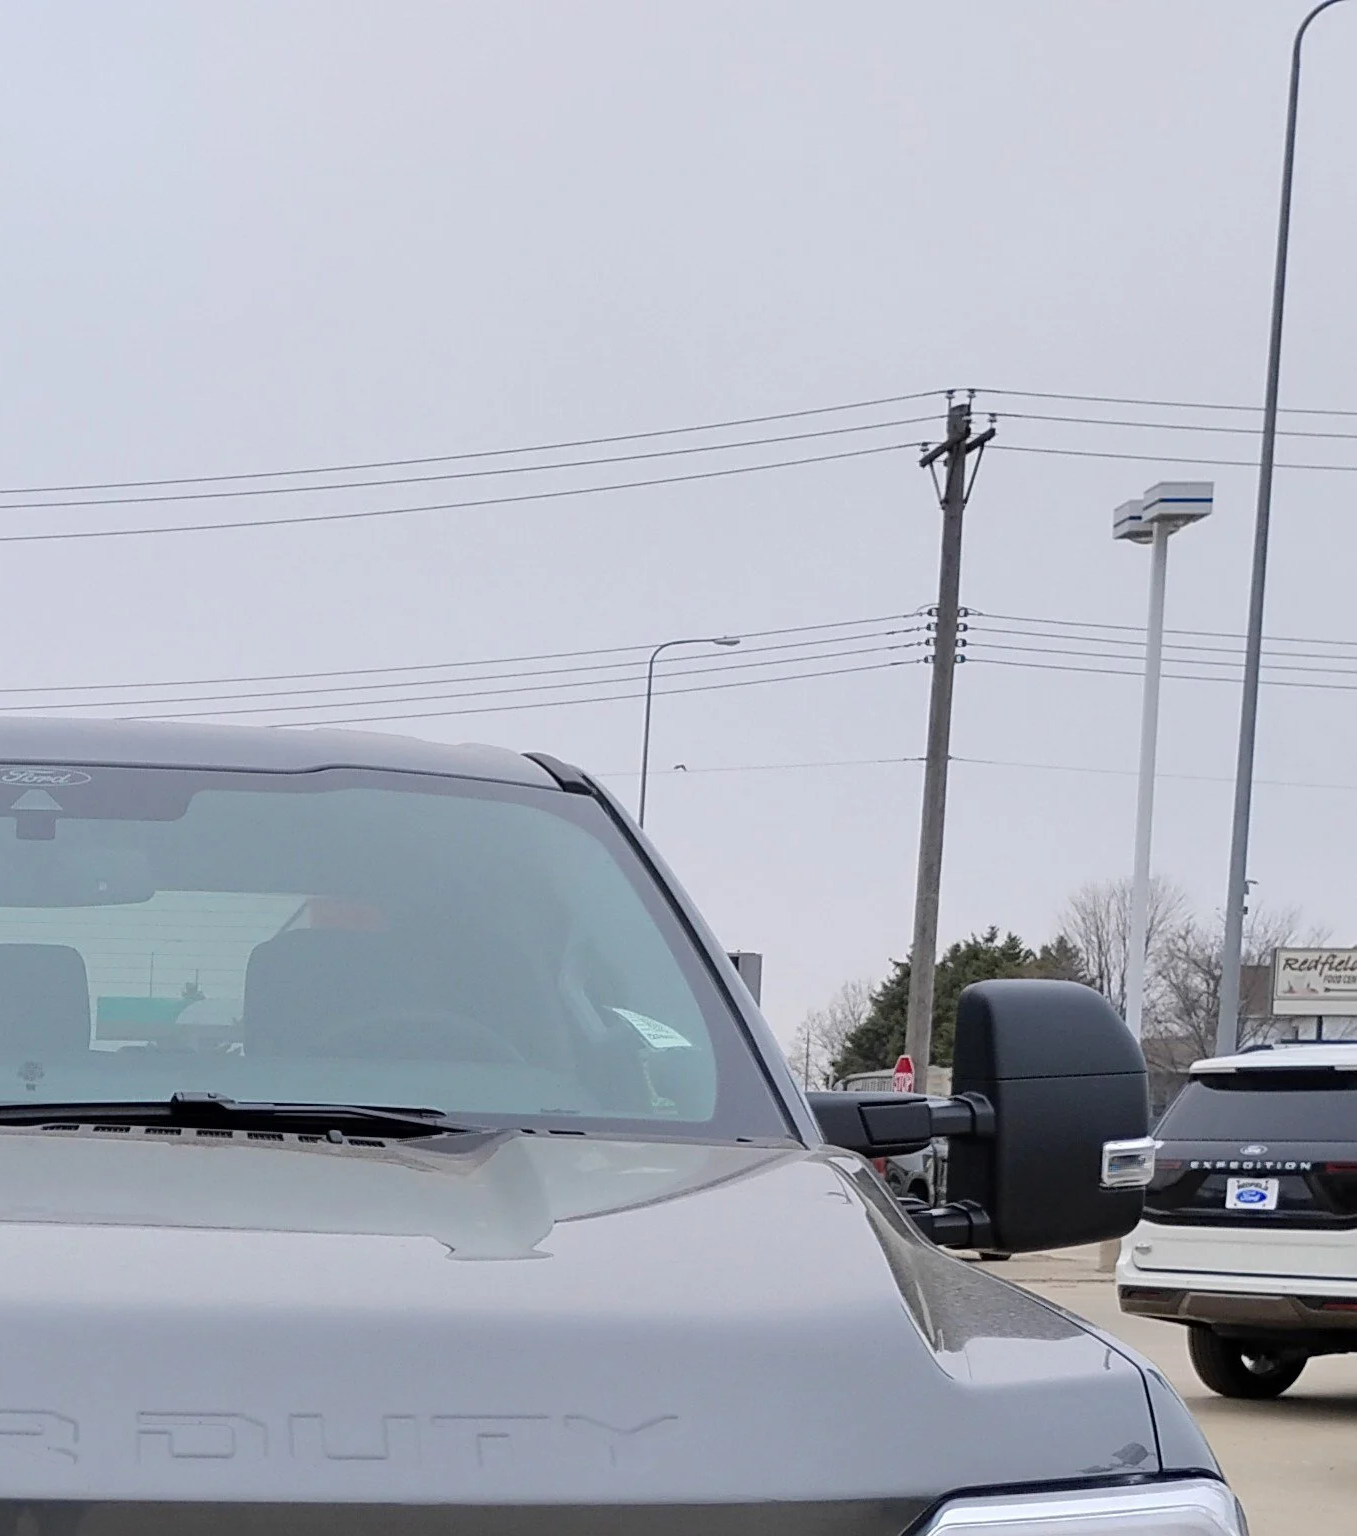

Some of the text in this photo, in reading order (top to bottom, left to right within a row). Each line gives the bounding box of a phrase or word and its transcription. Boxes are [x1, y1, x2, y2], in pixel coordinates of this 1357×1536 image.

[2, 769, 72, 784] Ford
[894, 1072, 913, 1092] STOP
[1190, 1161, 1311, 1170] EXPEDITION
[136, 1410, 679, 1468] DUTY
